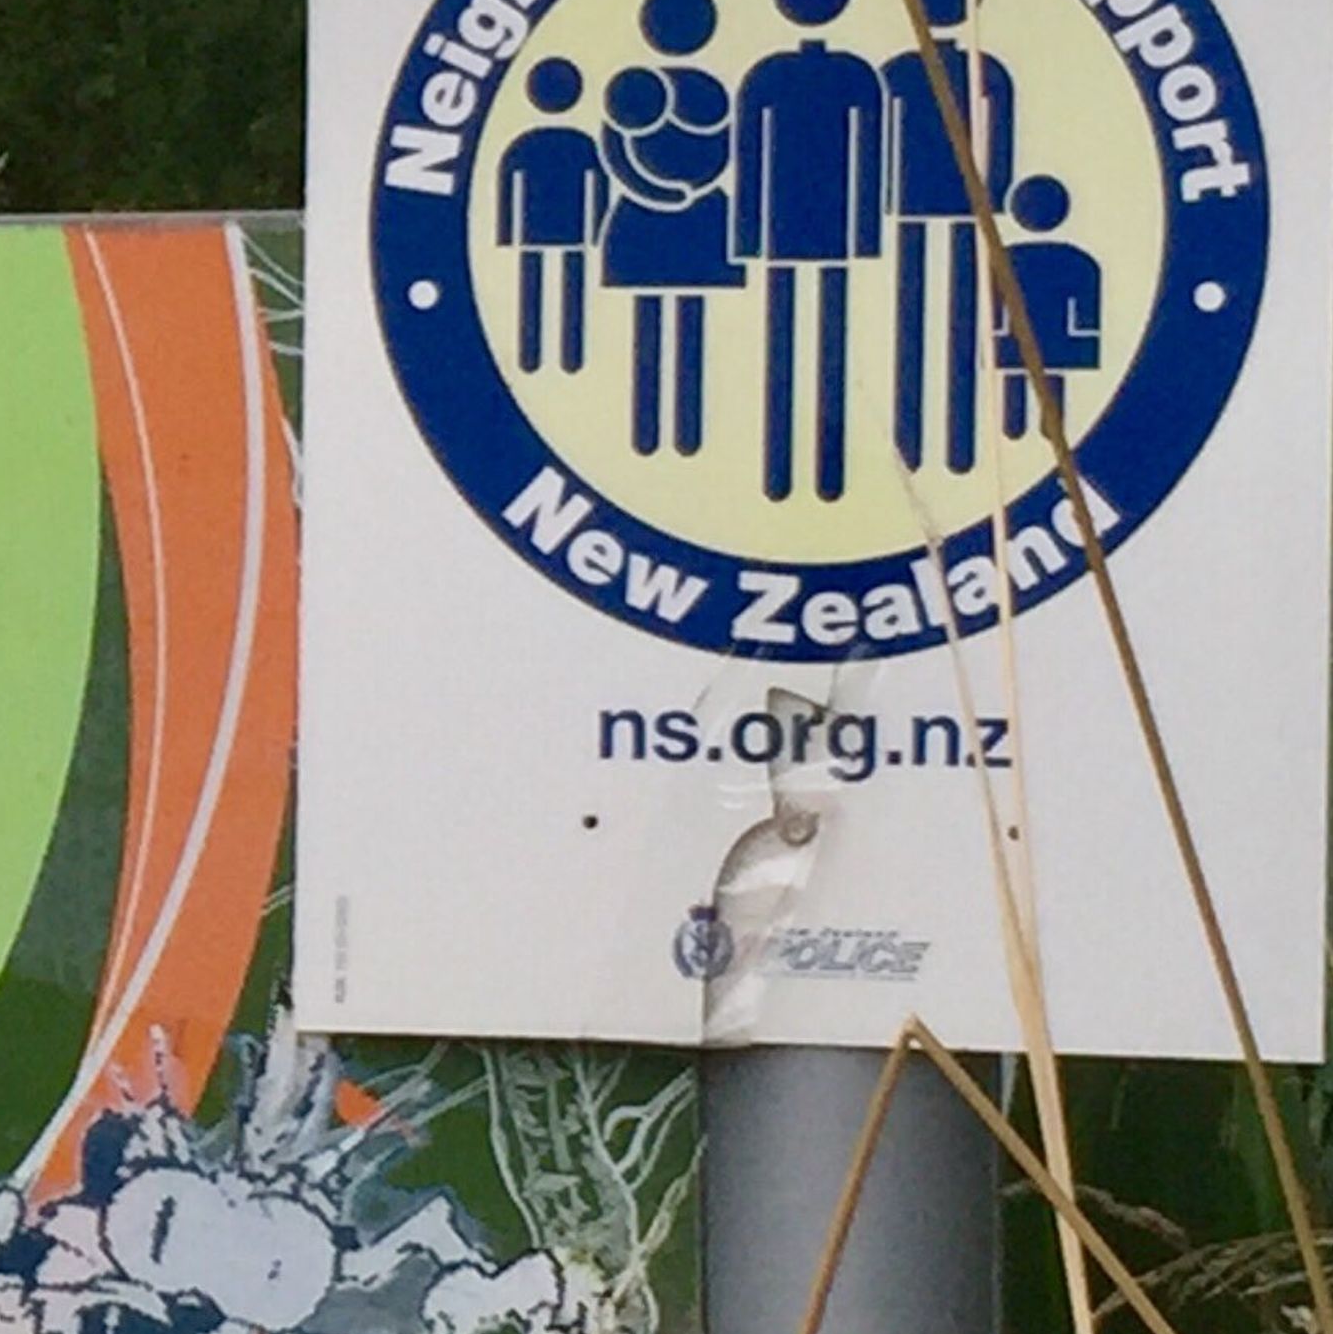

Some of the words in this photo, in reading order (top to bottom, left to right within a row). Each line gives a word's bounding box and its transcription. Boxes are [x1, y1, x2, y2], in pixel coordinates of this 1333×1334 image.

[503, 465, 710, 624] New
[732, 475, 1121, 645] Zealand
[599, 710, 1014, 783] ns.org.nz
